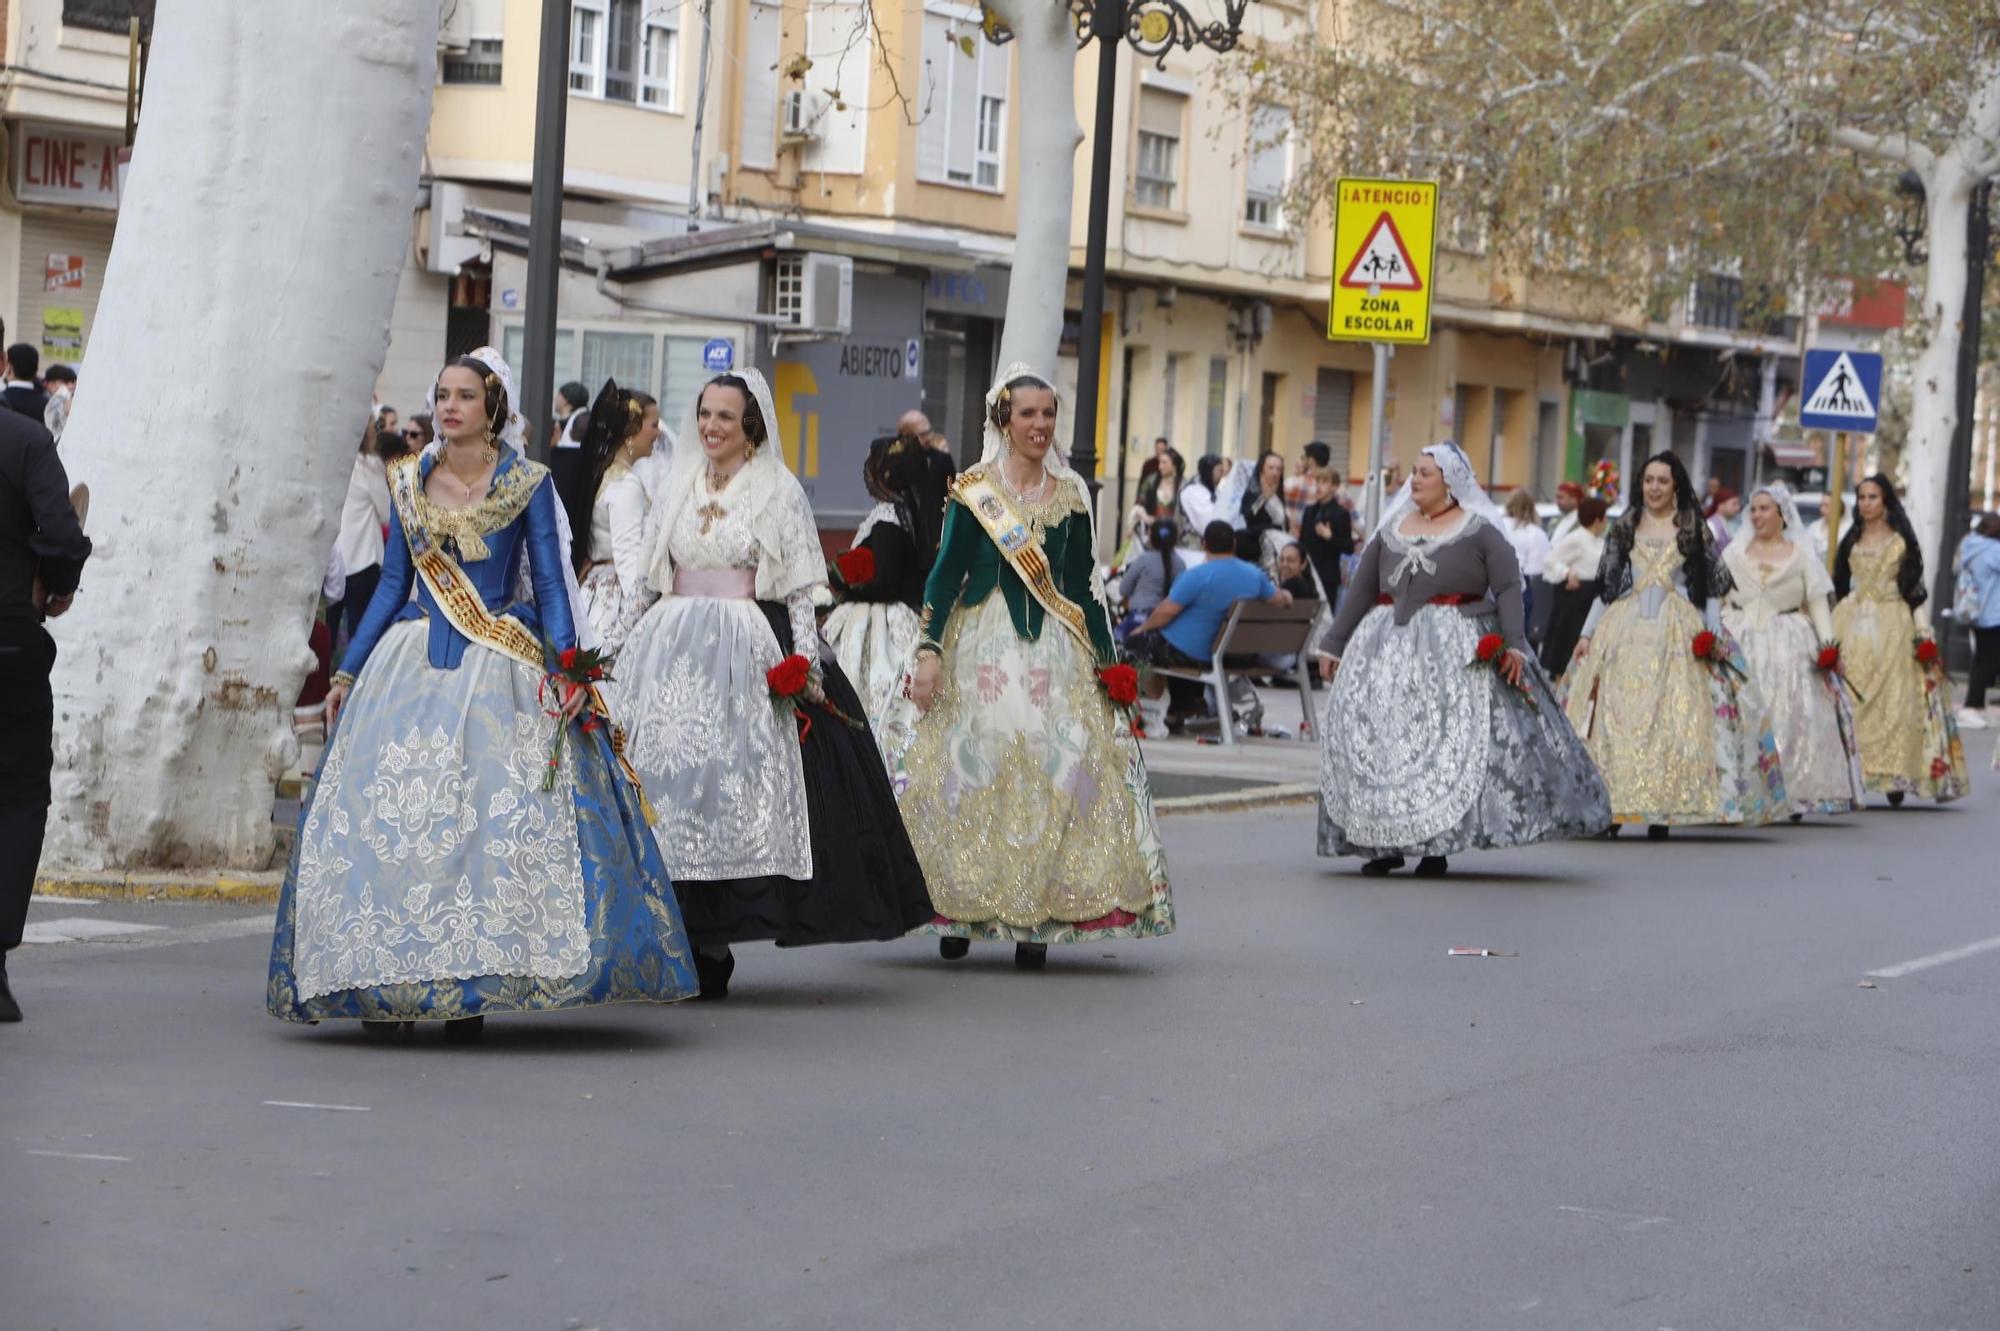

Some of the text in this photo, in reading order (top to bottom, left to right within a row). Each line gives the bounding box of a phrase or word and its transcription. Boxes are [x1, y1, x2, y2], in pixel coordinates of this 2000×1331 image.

[1360, 298, 1400, 313] ZONA
[1345, 316, 1413, 331] ESCOLAR
[839, 344, 901, 378] ABIERTO
